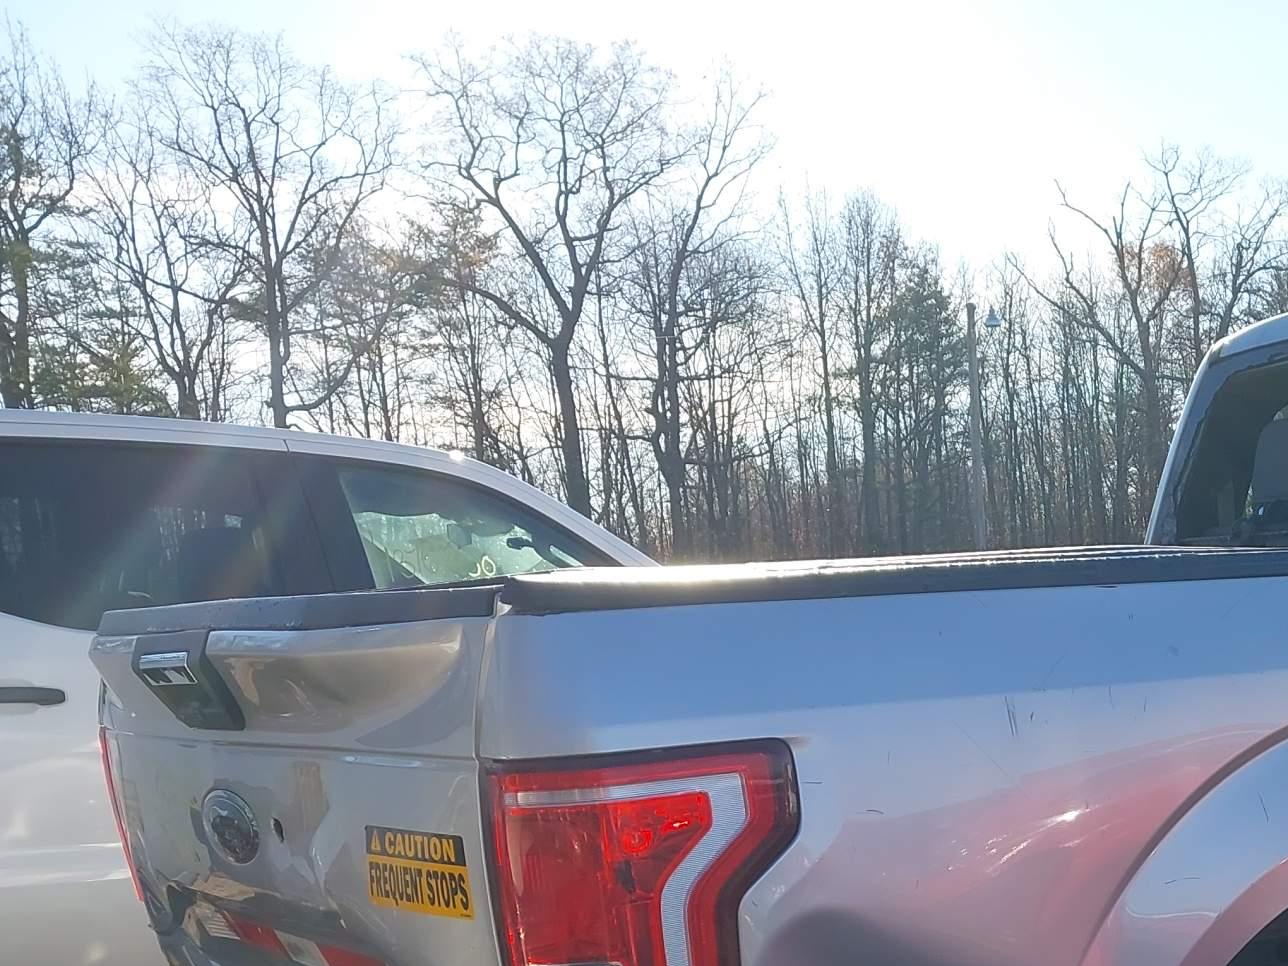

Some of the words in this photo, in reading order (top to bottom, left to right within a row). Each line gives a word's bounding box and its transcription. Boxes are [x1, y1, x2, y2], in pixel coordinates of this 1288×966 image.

[385, 831, 456, 863] CAUTION
[368, 861, 425, 906] FREQUENT
[426, 869, 469, 911] STOPS
